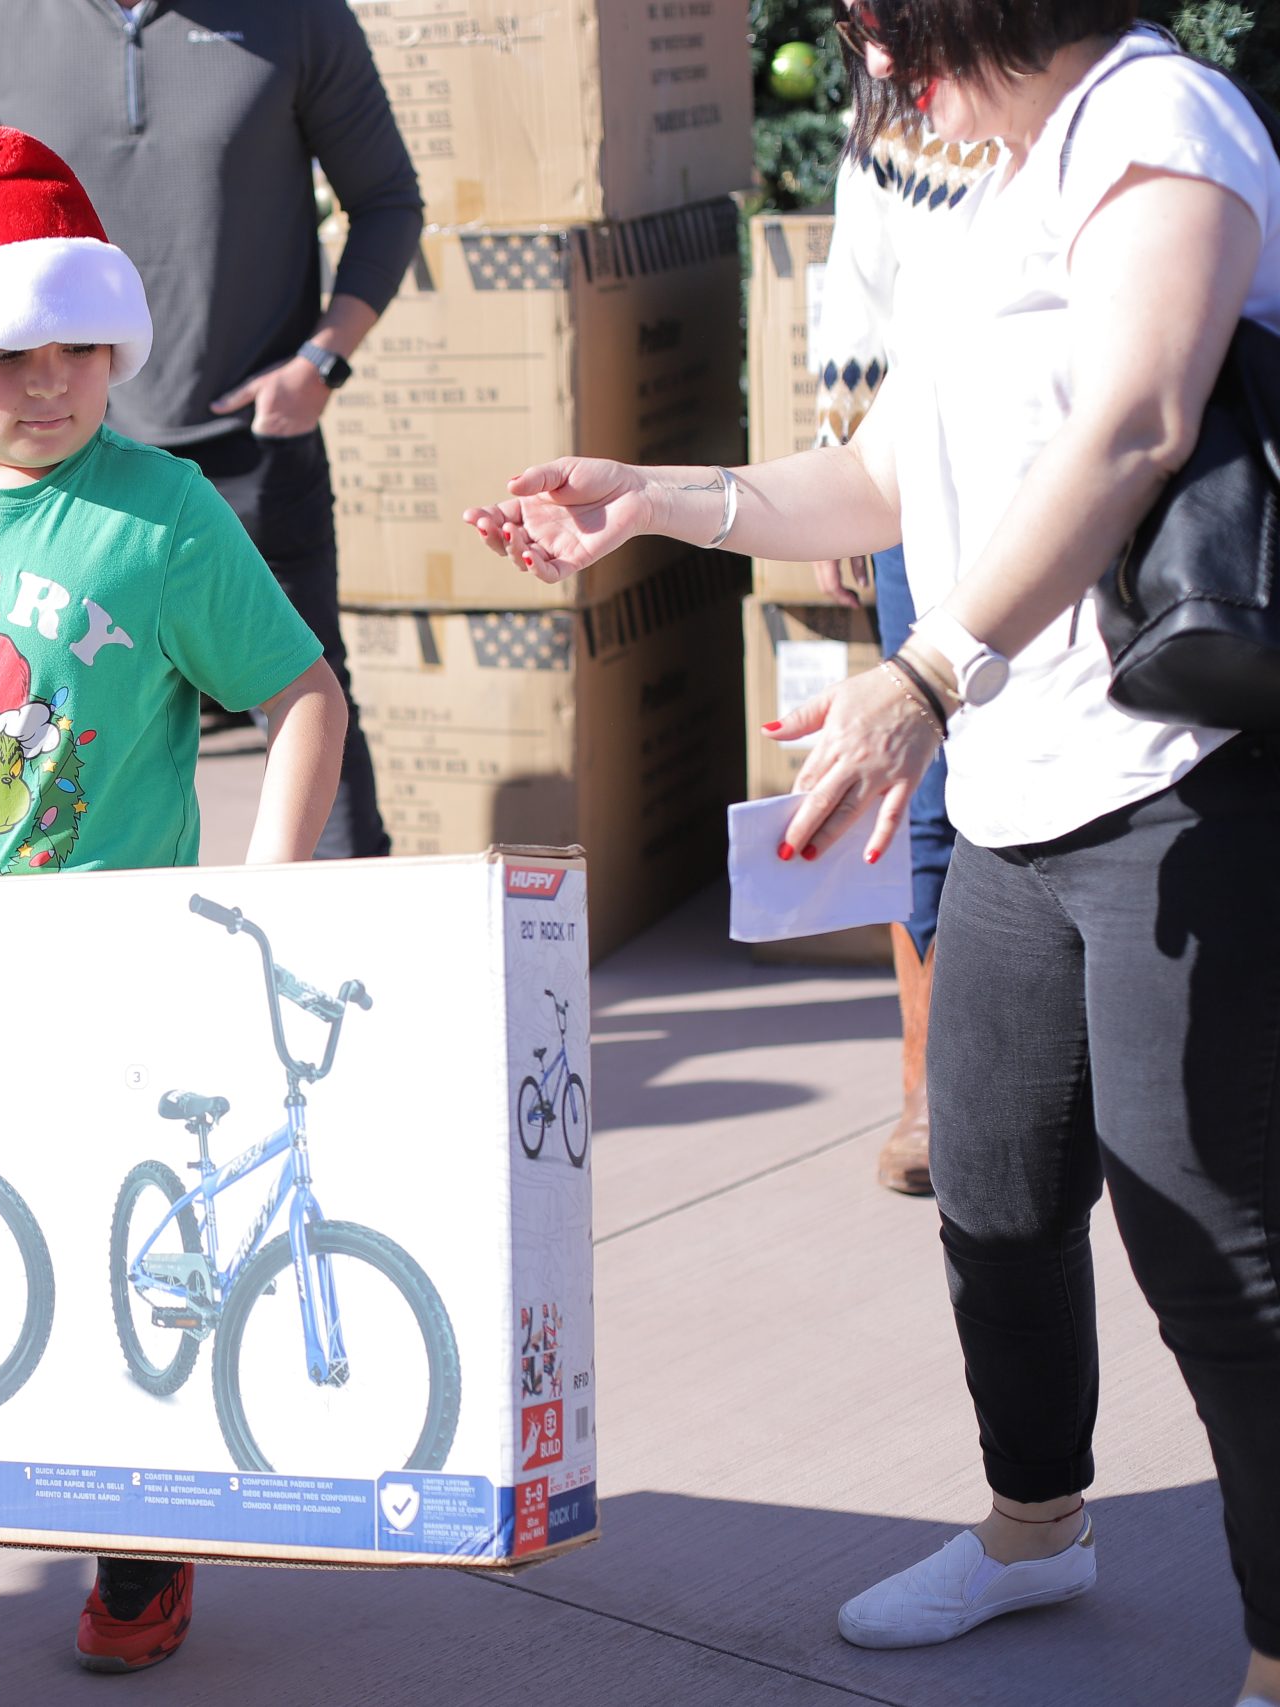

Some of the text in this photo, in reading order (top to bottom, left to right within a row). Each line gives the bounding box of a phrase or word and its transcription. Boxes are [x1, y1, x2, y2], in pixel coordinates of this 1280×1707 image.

[510, 871, 556, 889] HUFFY
[540, 920, 565, 941] ROCK
[567, 922, 575, 941] IT
[573, 1371, 589, 1390] RFID
[546, 1415, 556, 1431] EZ
[540, 1438, 561, 1459] BUILD
[24, 1466, 31, 1480] 1
[35, 1467, 97, 1477] QUICK ADJUST SEAT
[131, 1472, 141, 1486] 2
[144, 1472, 196, 1483] COASTER BRAKE
[63, 1480, 86, 1489] RAPIDE
[86, 1481, 96, 1489] DE
[96, 1482, 105, 1490] LA
[106, 1483, 125, 1491] SELLE
[144, 1484, 163, 1493] FREIN
[229, 1477, 239, 1491] 3
[242, 1478, 334, 1490] COMFORTABLE PADDED SEAT
[35, 1490, 62, 1499] ASIENTO
[63, 1491, 72, 1499] DE
[73, 1492, 97, 1501] AJUSTE
[320, 1494, 367, 1504] CONFORTABLE
[525, 1483, 544, 1505] 5-9
[144, 1496, 216, 1508] FRENOS CONTRAPEDAL
[272, 1503, 301, 1512] ASIENTO
[302, 1505, 342, 1514] ACOJINADO
[548, 1505, 570, 1528] ROCK
[571, 1502, 580, 1520] IT
